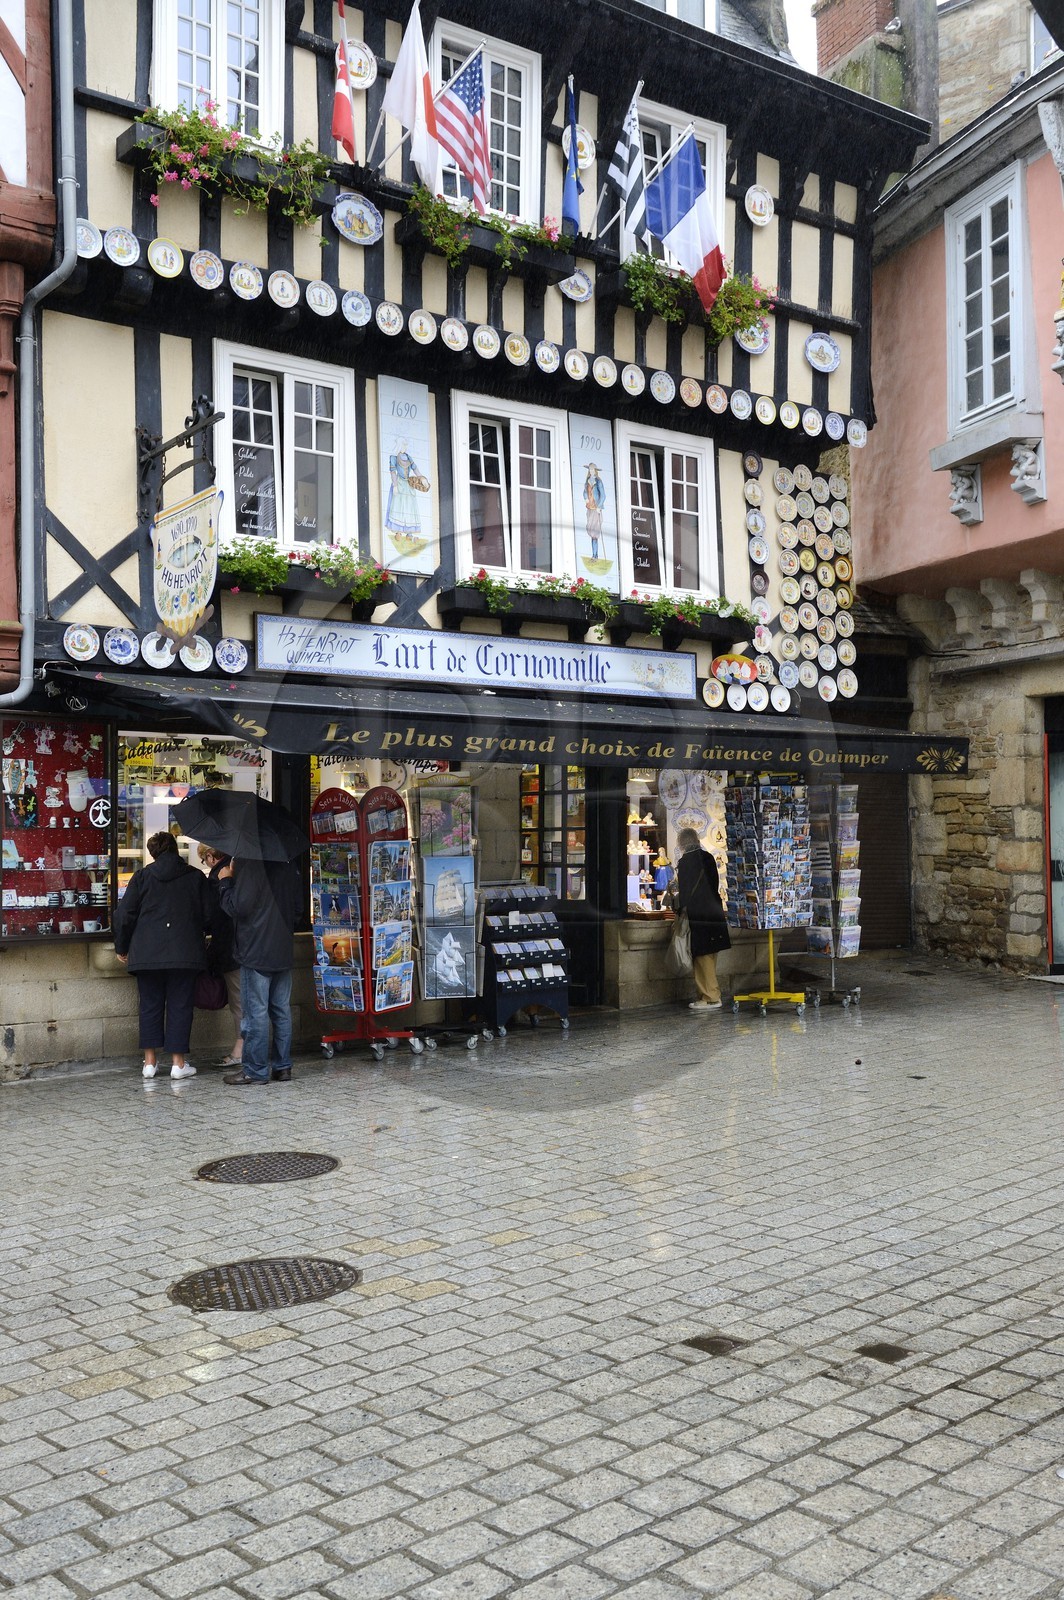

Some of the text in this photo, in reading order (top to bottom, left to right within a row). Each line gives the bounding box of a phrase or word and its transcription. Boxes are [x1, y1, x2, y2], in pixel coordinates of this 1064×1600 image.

[391, 400, 418, 420] 1690
[580, 434, 602, 451] 1990
[372, 632, 612, 684] L'art de Cornouaille
[117, 740, 182, 762] Cadeaux
[201, 736, 268, 768] Souvenirs
[322, 722, 890, 768] Le plus grand choix de Faïence de Quimper
